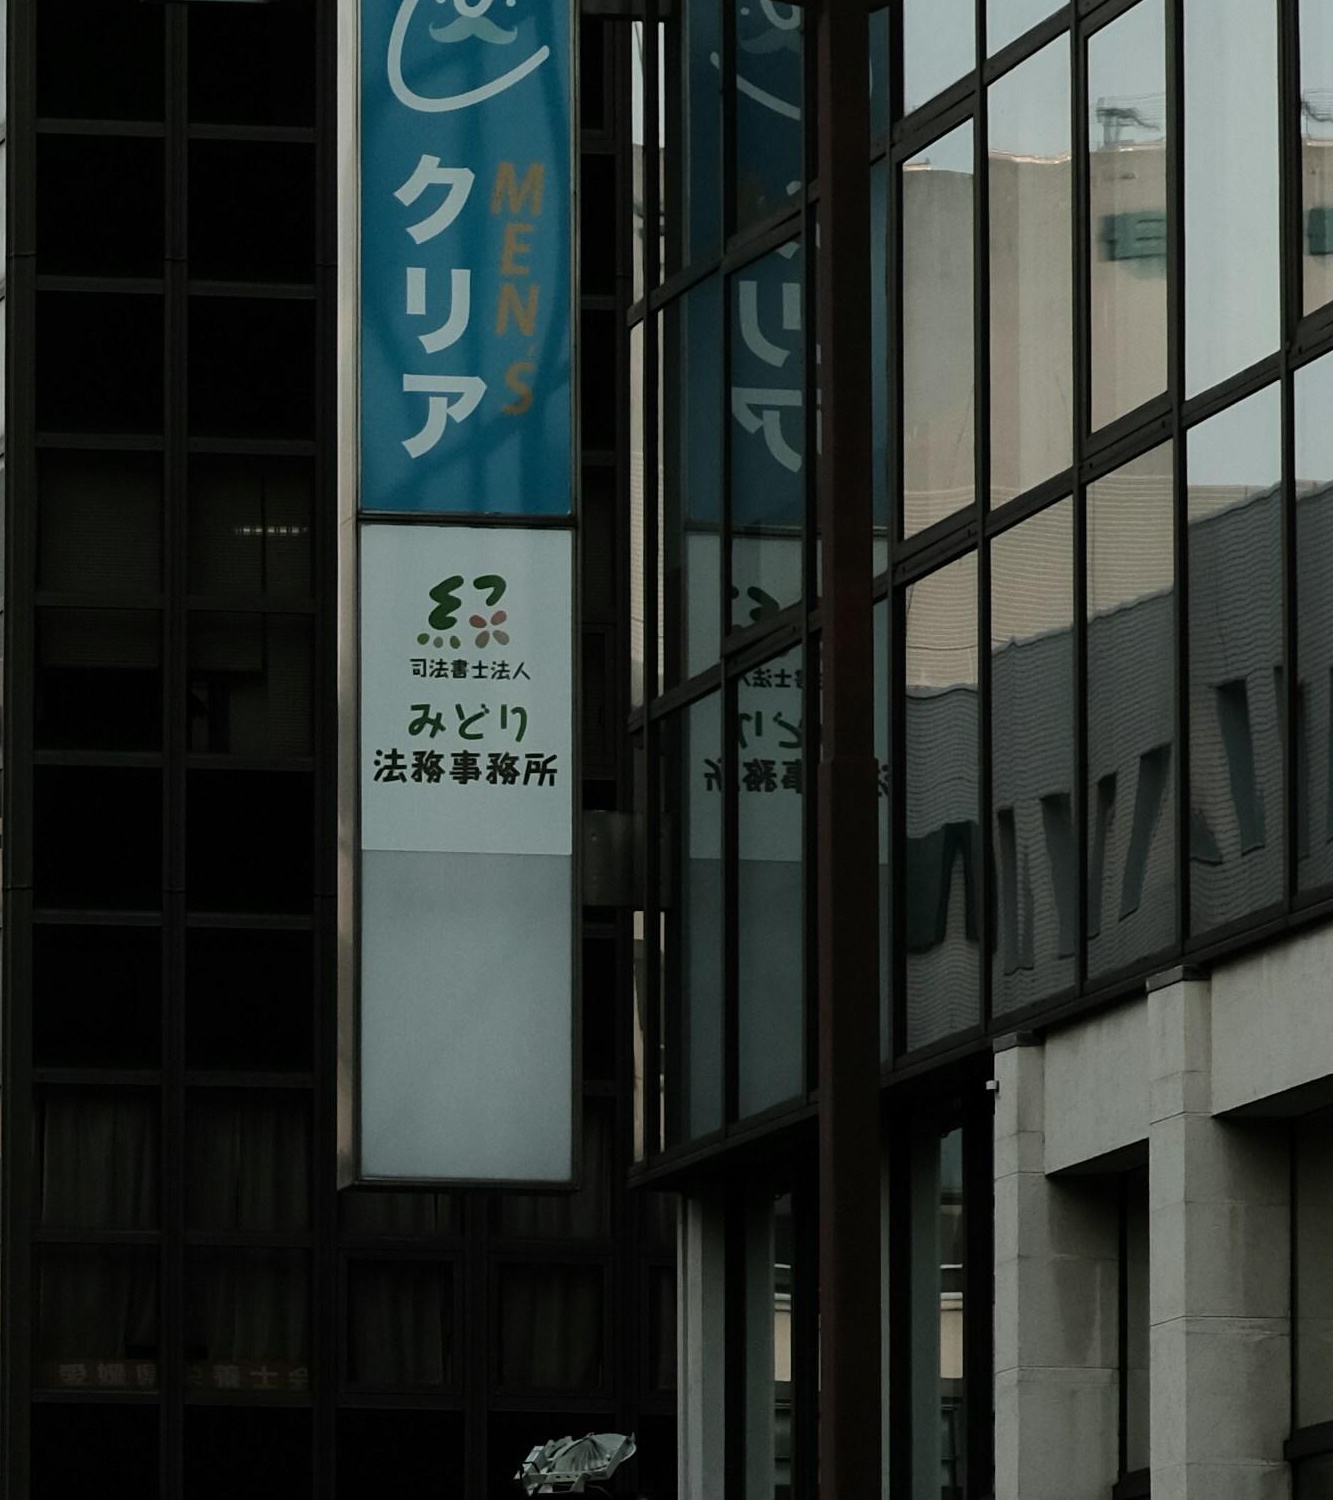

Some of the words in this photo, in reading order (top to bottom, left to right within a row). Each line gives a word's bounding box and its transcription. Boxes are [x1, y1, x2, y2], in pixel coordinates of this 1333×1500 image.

[393, 154, 488, 459] クリア
[409, 657, 532, 681] 司法書士法人
[408, 702, 528, 742] みどり
[372, 747, 558, 788] 法務事務所
